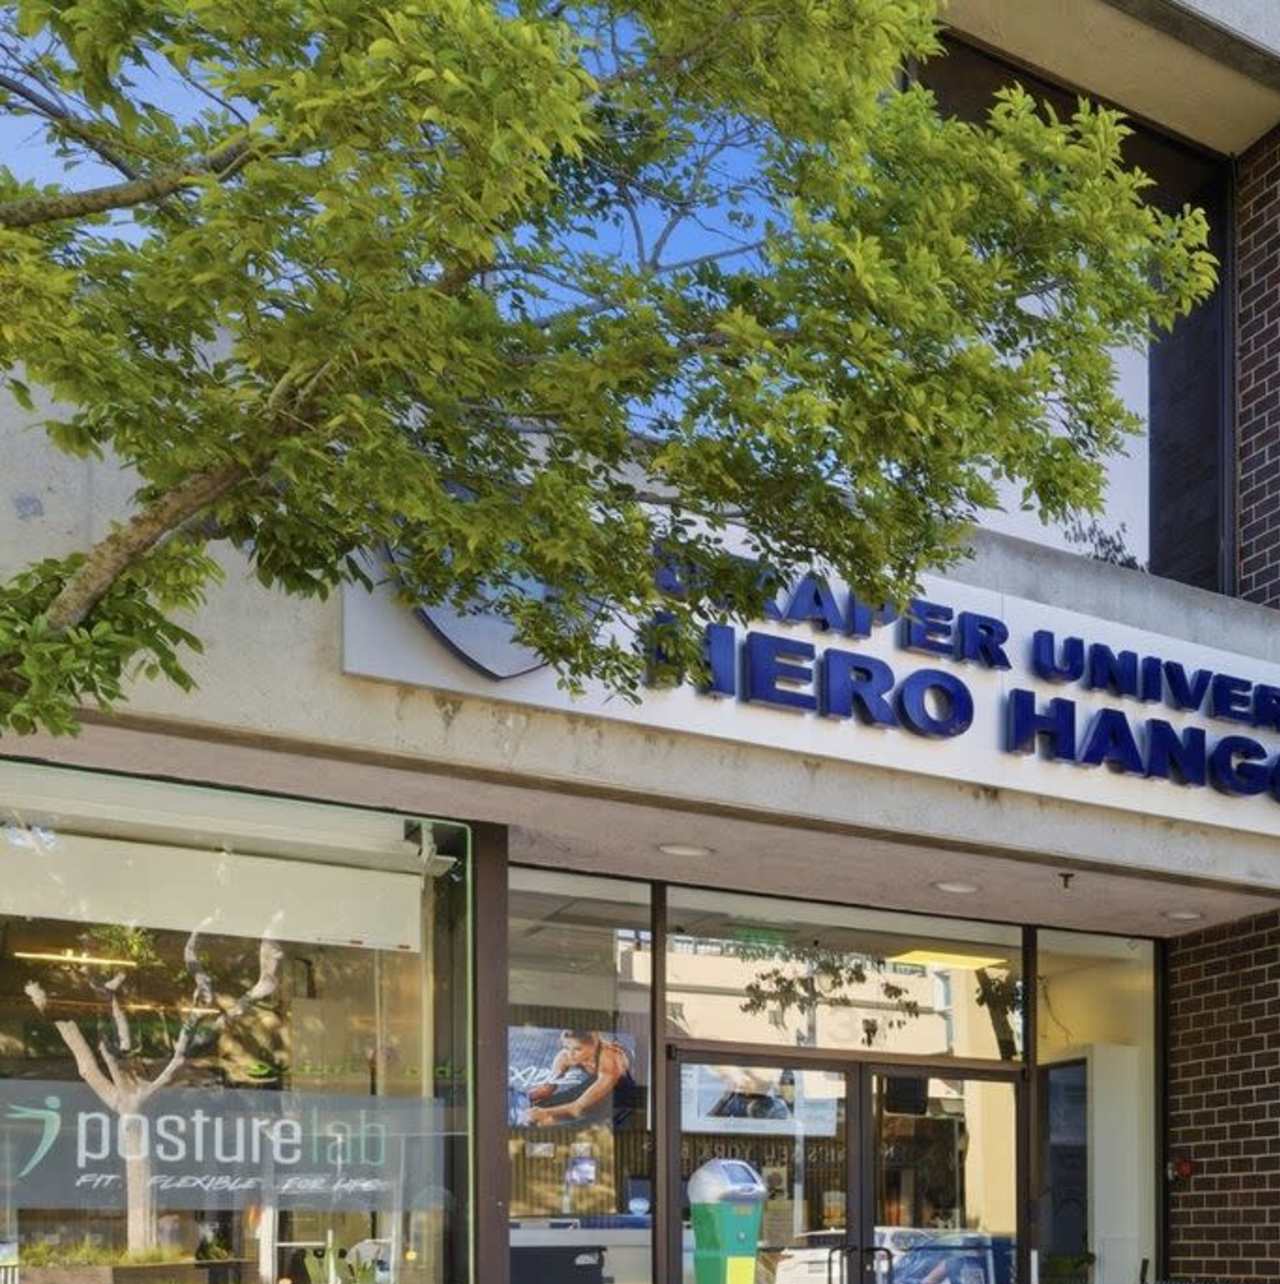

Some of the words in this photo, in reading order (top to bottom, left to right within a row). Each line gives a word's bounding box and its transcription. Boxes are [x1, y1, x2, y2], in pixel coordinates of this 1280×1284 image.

[654, 541, 1013, 670] APER
[76, 1105, 388, 1168] posturelab
[146, 1173, 263, 1191] FLEXIBLE
